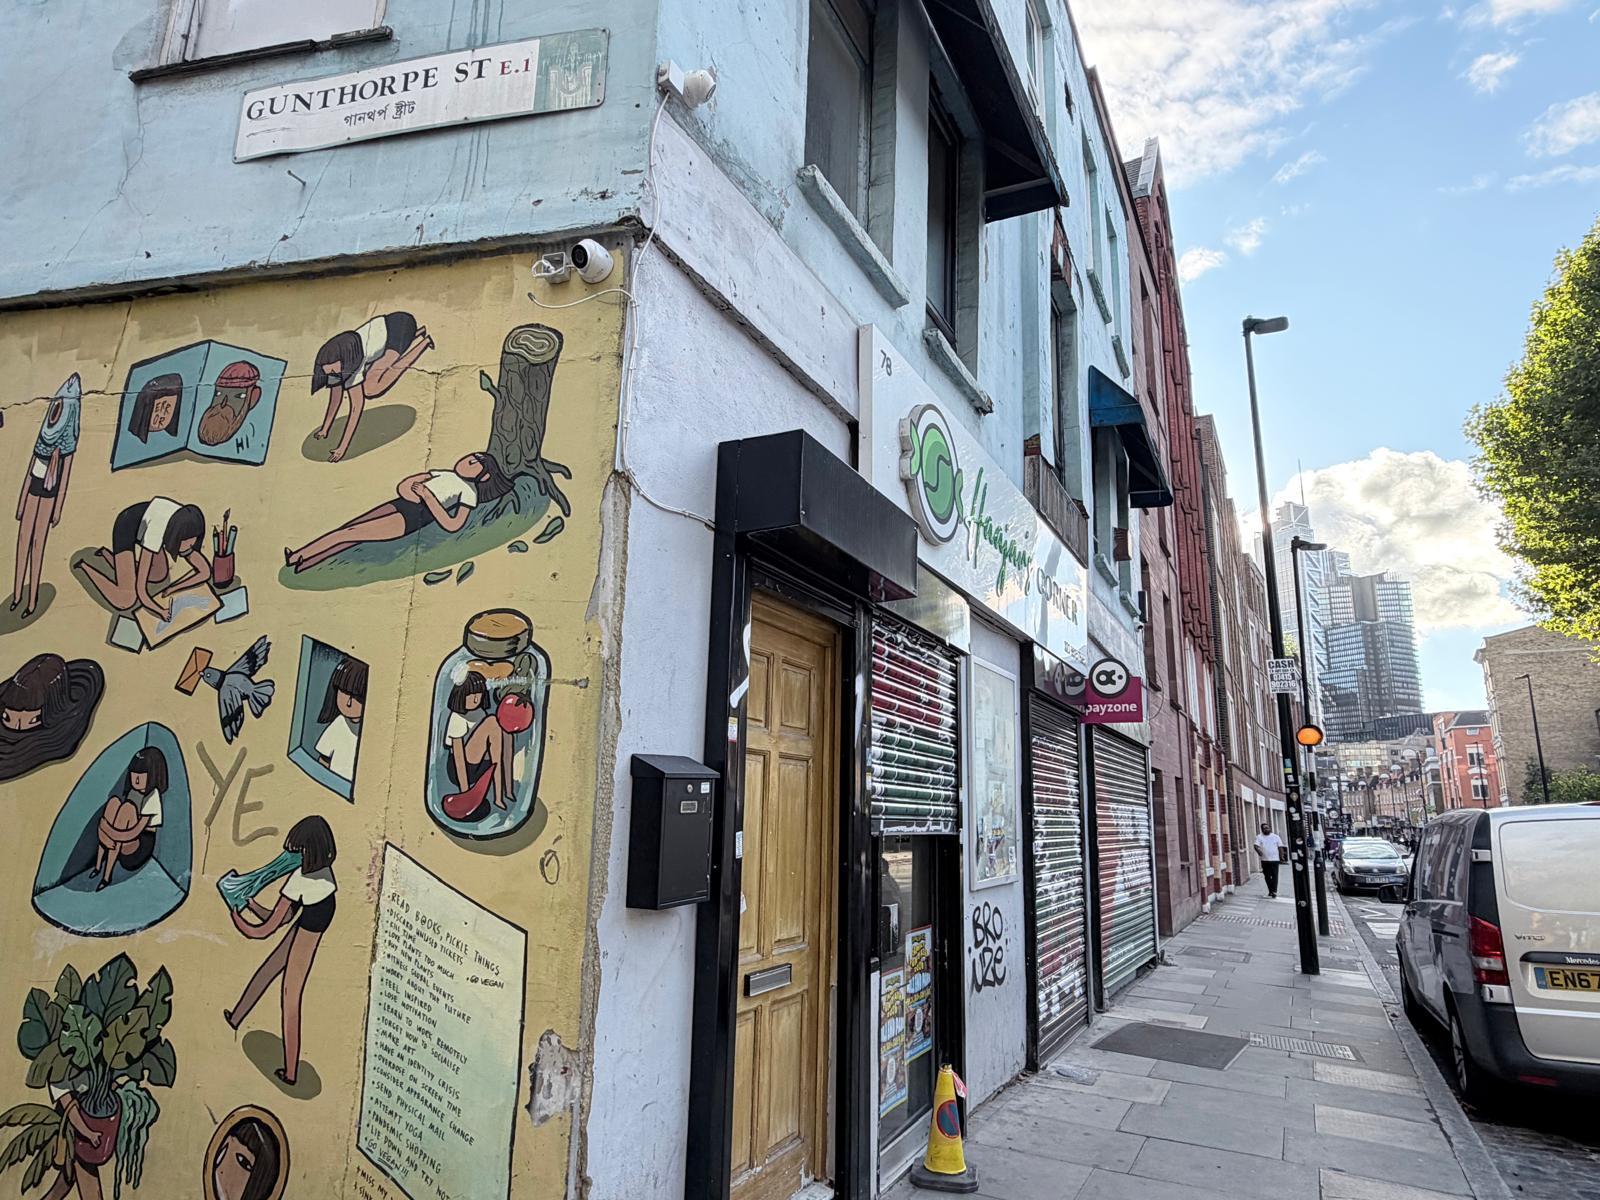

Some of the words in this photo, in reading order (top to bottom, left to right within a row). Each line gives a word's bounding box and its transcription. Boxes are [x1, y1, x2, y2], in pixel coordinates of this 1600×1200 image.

[246, 66, 438, 120] GUNTHORPE
[454, 58, 491, 83] ST
[499, 58, 531, 76] E.1
[880, 349, 892, 376] 78
[152, 415, 165, 427] OR
[235, 436, 250, 454] HI
[1037, 567, 1078, 625] CORNER
[1268, 660, 1294, 669] CASH
[1086, 703, 1137, 716] payzone
[196, 741, 279, 847] YE
[390, 909, 413, 931] DISCARD
[416, 928, 438, 949] UNUSED
[440, 944, 463, 966] TICKETS
[392, 893, 410, 913] READ
[446, 932, 469, 955] PICKLE
[474, 950, 500, 976] THINGS
[403, 929, 416, 944] TIME
[973, 901, 1003, 949] BRO
[388, 940, 398, 951] BUY
[401, 949, 412, 962] NEW
[415, 958, 434, 978] PLANTS
[389, 931, 400, 943] LOVE
[403, 940, 422, 957] PLANTS
[425, 955, 435, 967] TOO
[437, 965, 454, 980] MUCH
[386, 978, 400, 994] FEEL
[405, 990, 432, 1012] INSPIRED
[407, 979, 424, 995] ABOUT
[445, 1003, 471, 1024] FUTURE
[433, 983, 454, 1003] EVENTS
[470, 975, 480, 984] GO
[481, 978, 504, 989] VEGAN
[385, 990, 397, 1003] LOSE
[401, 1001, 437, 1028] MOTIVATION
[381, 1030, 399, 1046] MAKE
[403, 1044, 416, 1055] ART
[382, 1016, 403, 1034] FORGET
[422, 1039, 428, 1049] TO
[431, 1048, 460, 1075] SOCIALISE
[384, 1002, 402, 1020] LEARN
[406, 1016, 413, 1026] TO
[417, 1025, 432, 1041] WORK
[437, 1037, 467, 1064] REMOTELY
[378, 1055, 405, 1076] OVERDOSE
[409, 1074, 417, 1084] ON
[421, 1083, 443, 1102] SCREEN
[447, 1101, 462, 1117] TIME
[380, 1041, 394, 1056] HAVE
[397, 1052, 404, 1061] AN
[408, 1058, 435, 1081] IDENTITY
[438, 1078, 460, 1100] CRISIS
[375, 1098, 402, 1124] ATTEMPT
[405, 1120, 423, 1142] YOGA
[376, 1081, 392, 1099] SEND
[396, 1095, 425, 1126] PHYSICAL
[428, 1122, 445, 1141] MAIL
[377, 1067, 403, 1090] CONSIDER
[449, 1121, 475, 1146] CHANGE
[368, 1139, 377, 1150] GO
[371, 1125, 381, 1140] LIE
[384, 1135, 402, 1158] DOWN
[405, 1155, 418, 1172] AND
[421, 1169, 434, 1186] TRY
[372, 1111, 403, 1142] PANDEMIC
[406, 1139, 442, 1174] SHOPPING
[361, 1170, 375, 1188] MISS
[377, 1184, 388, 1200] MY
